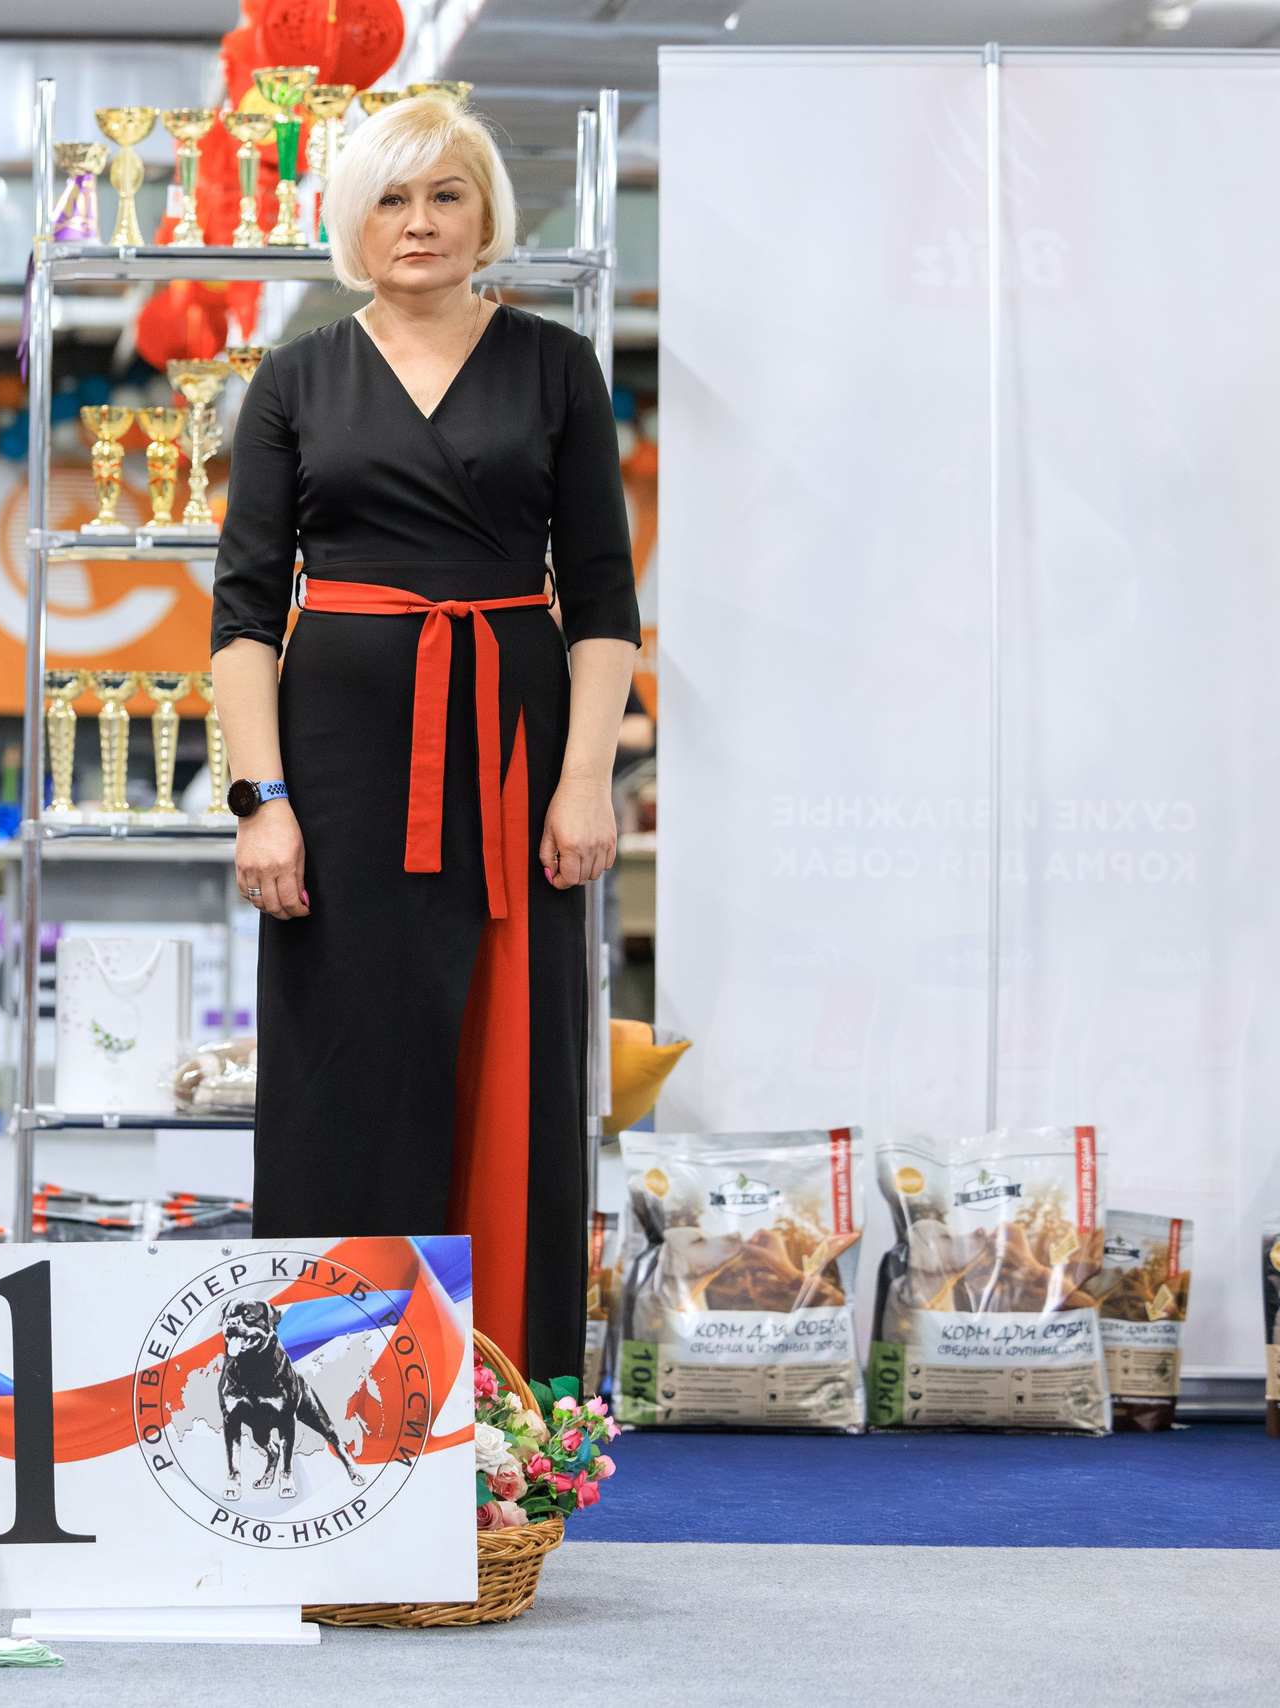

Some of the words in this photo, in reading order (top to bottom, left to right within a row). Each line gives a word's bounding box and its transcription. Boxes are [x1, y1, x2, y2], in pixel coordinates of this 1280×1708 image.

[138, 1264, 247, 1473] РОТВЕЙЛЕР
[271, 1257, 372, 1303] КЛУБ
[378, 1308, 428, 1469] РОССИИ
[210, 1498, 368, 1543] РКФ-НКПР
